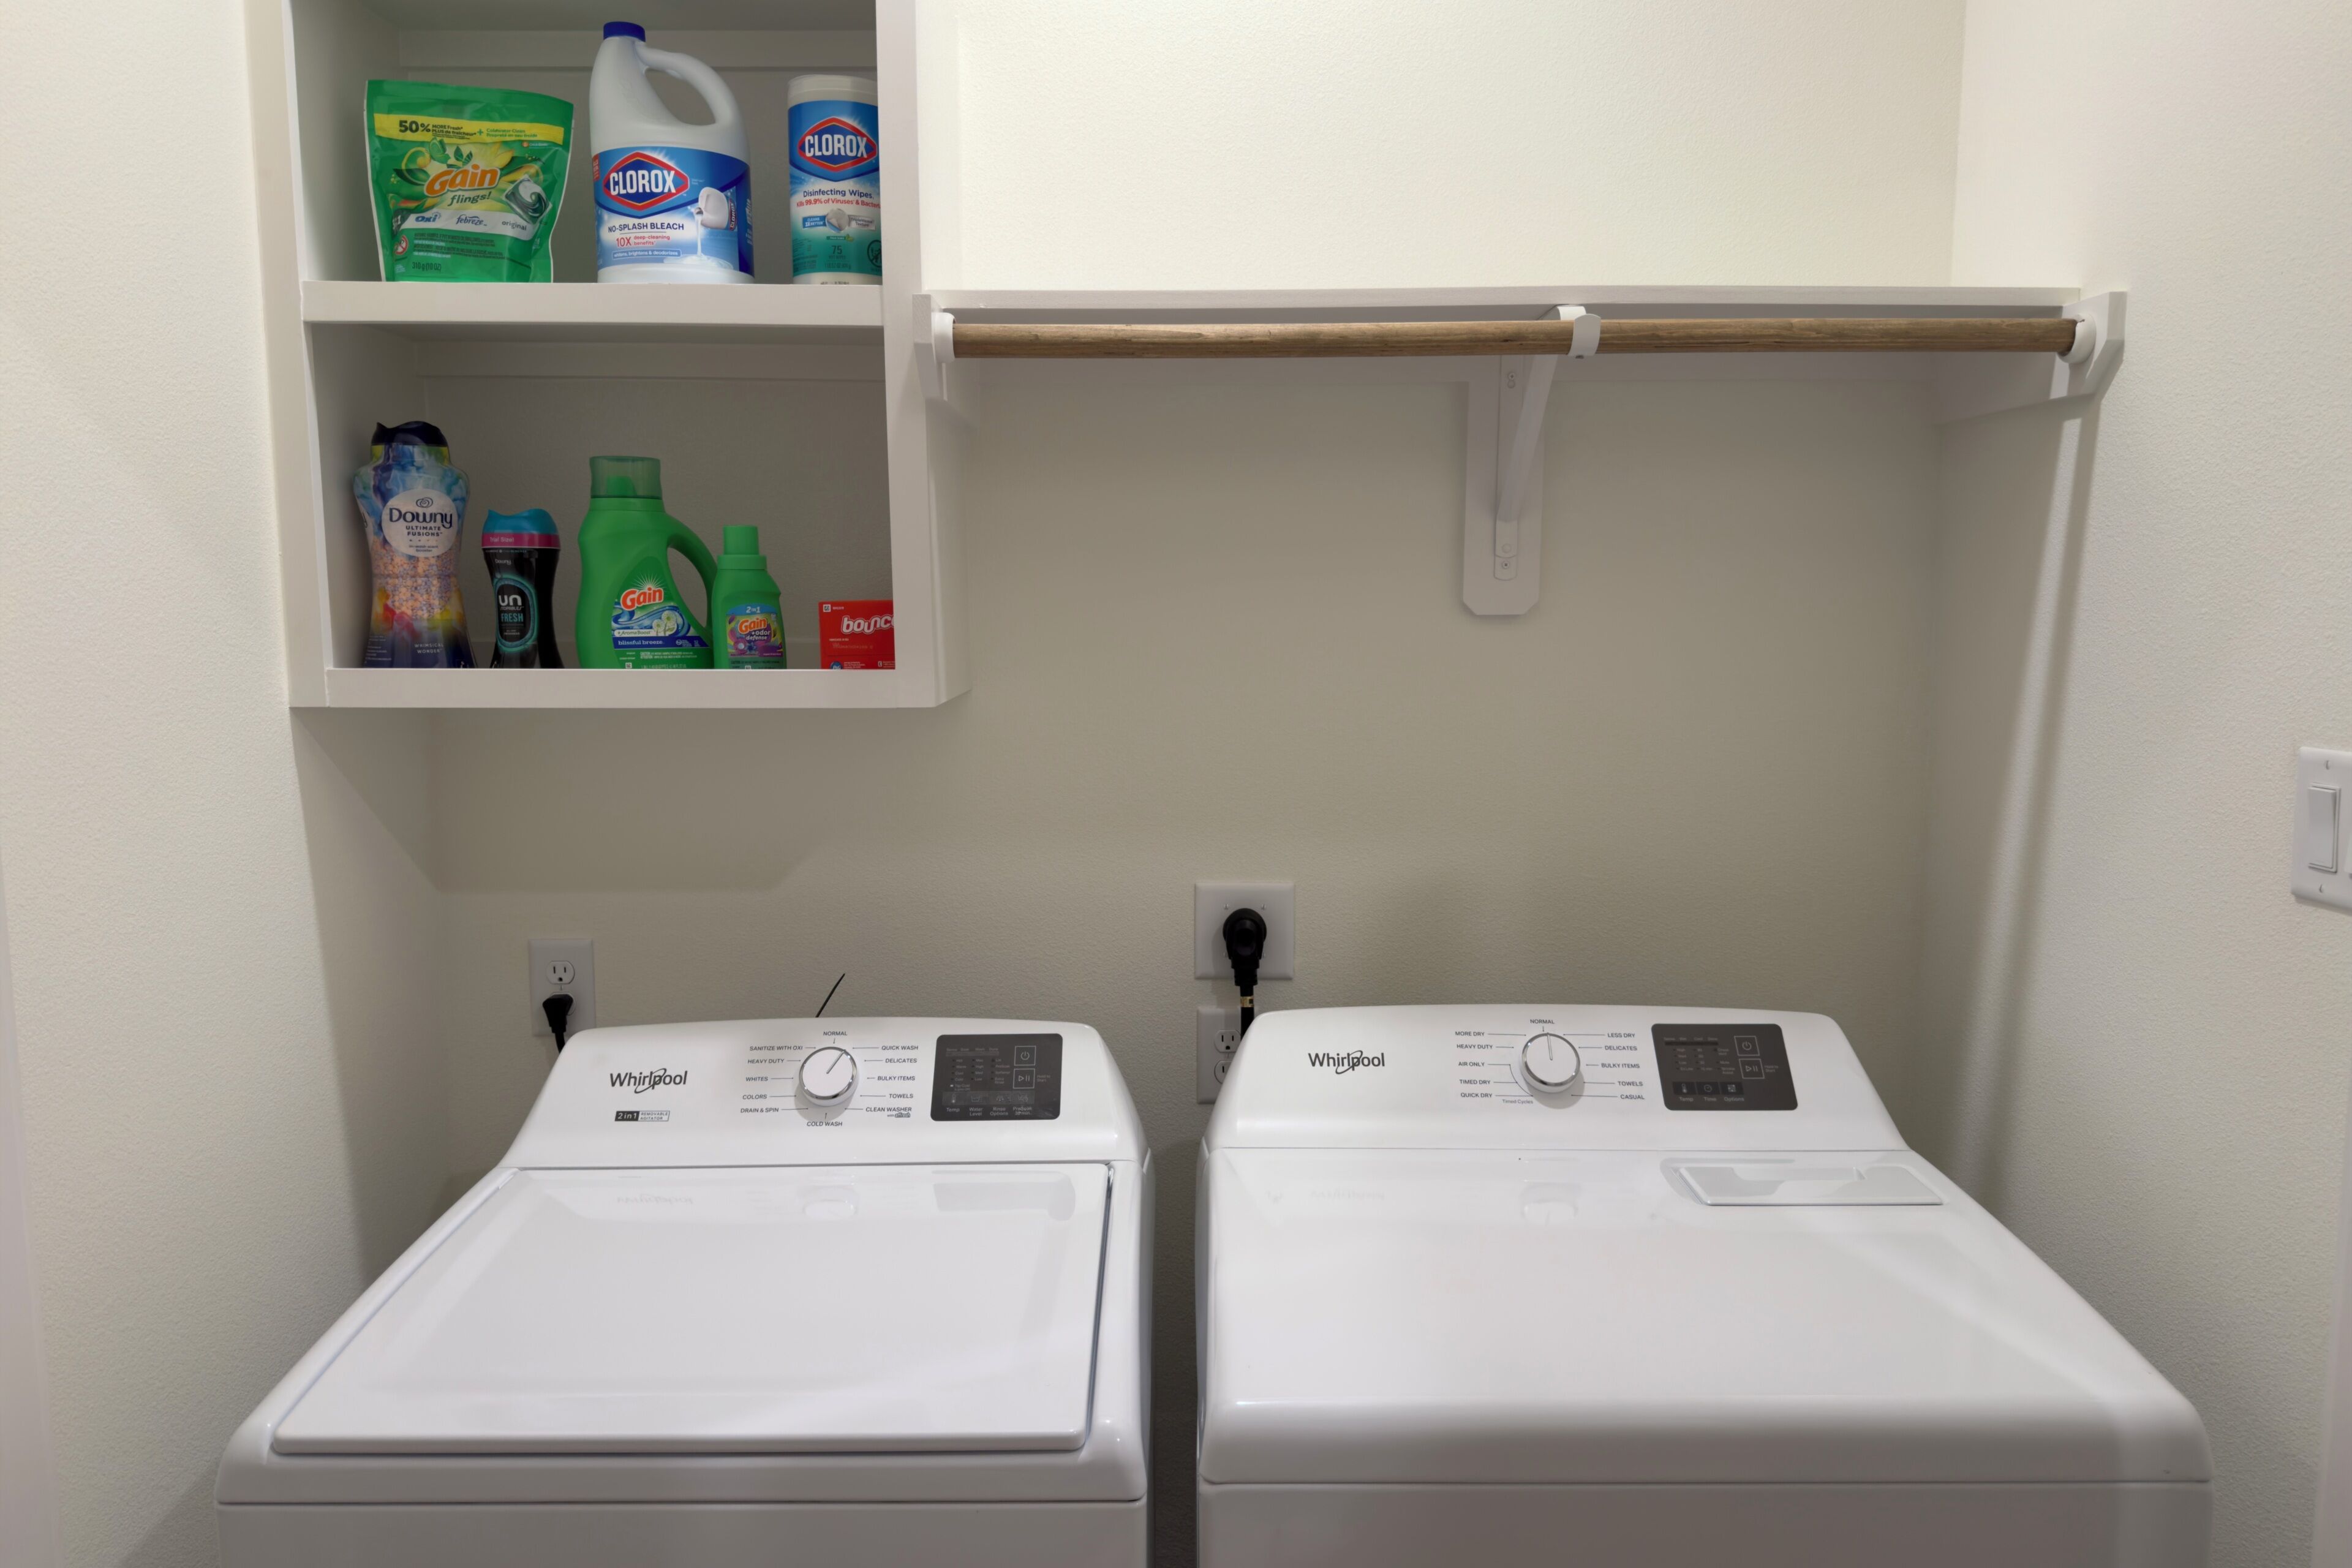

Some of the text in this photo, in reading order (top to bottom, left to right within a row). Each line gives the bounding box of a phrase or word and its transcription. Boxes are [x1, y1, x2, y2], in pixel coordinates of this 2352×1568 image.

[399, 120, 431, 133] 50%
[805, 134, 867, 158] CLOROX
[424, 163, 500, 196] Gain
[610, 170, 676, 195] CLOROX
[447, 191, 492, 206] flings!
[803, 189, 846, 197] Disinfecting
[456, 214, 484, 225] febreze
[502, 221, 527, 231] original
[608, 222, 648, 233] NO-SPLASH
[616, 236, 631, 247] 10X
[832, 246, 842, 254] 75
[389, 508, 453, 529] Downy
[620, 587, 664, 611] Gain
[500, 612, 524, 622] FRESH
[842, 616, 894, 633] bounc
[737, 617, 767, 635] Gain
[1308, 1050, 1385, 1074] Whirlpool
[610, 1068, 688, 1093] Whirlpool
